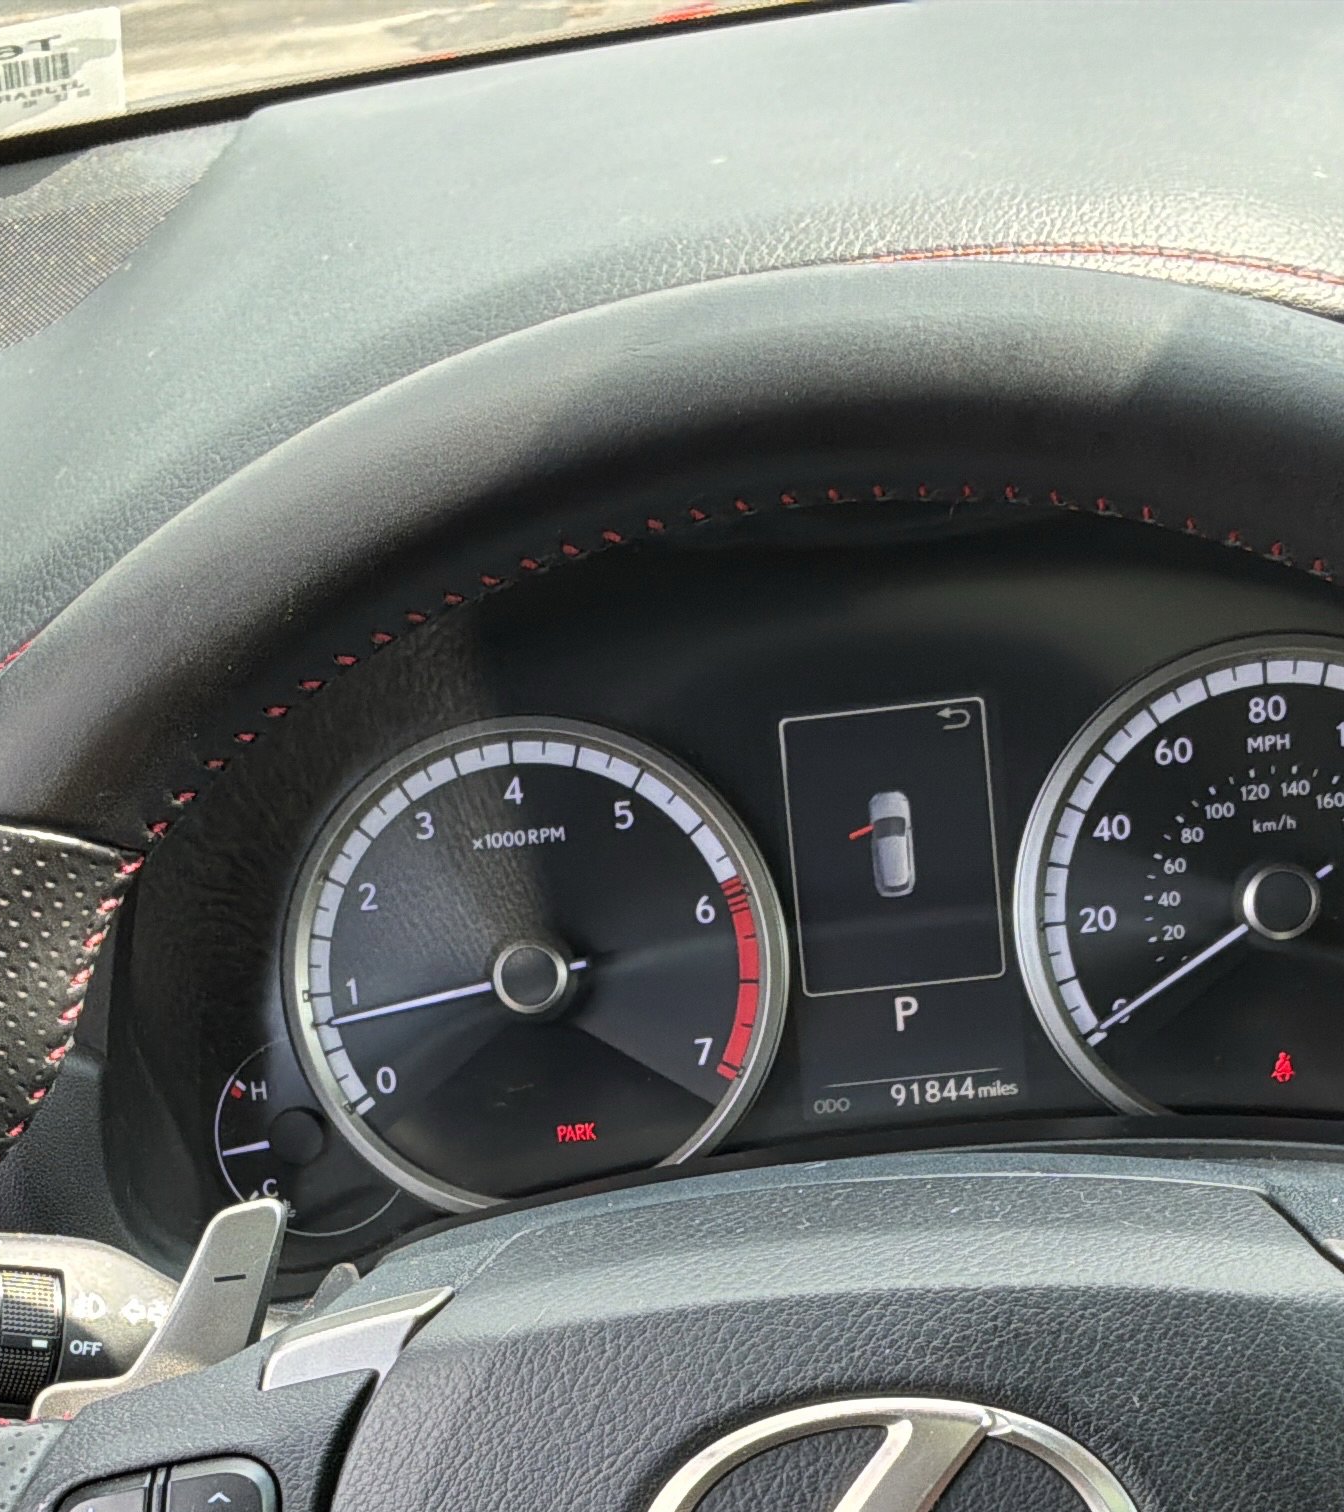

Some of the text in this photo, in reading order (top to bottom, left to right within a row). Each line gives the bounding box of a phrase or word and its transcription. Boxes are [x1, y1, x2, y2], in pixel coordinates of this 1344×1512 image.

[1249, 695, 1286, 723] 80
[1155, 737, 1193, 765] 60
[1247, 734, 1290, 753] MPH
[504, 777, 523, 804] 4
[1241, 784, 1270, 801] 120
[1281, 779, 1310, 797] 140
[614, 801, 634, 829] 5
[1205, 802, 1235, 819] 100
[416, 812, 434, 840] 3
[1093, 815, 1130, 841] 40
[1253, 814, 1296, 832] km/h
[528, 826, 566, 845] RPM
[1181, 827, 1204, 843] 80
[1164, 858, 1186, 874] 60
[359, 882, 378, 911] 2
[1158, 891, 1181, 906] 40
[696, 896, 715, 923] 6
[1080, 906, 1116, 933] 20
[1162, 924, 1185, 941] 20
[346, 978, 358, 1005] 1
[895, 996, 918, 1031] P
[695, 1038, 712, 1065] 7
[251, 1081, 267, 1100] H
[377, 1067, 396, 1094] 0
[813, 1076, 1019, 1115] ODO 91844 miles
[557, 1123, 596, 1142] PARK
[262, 1178, 280, 1198] C
[70, 1339, 102, 1357] OFF
